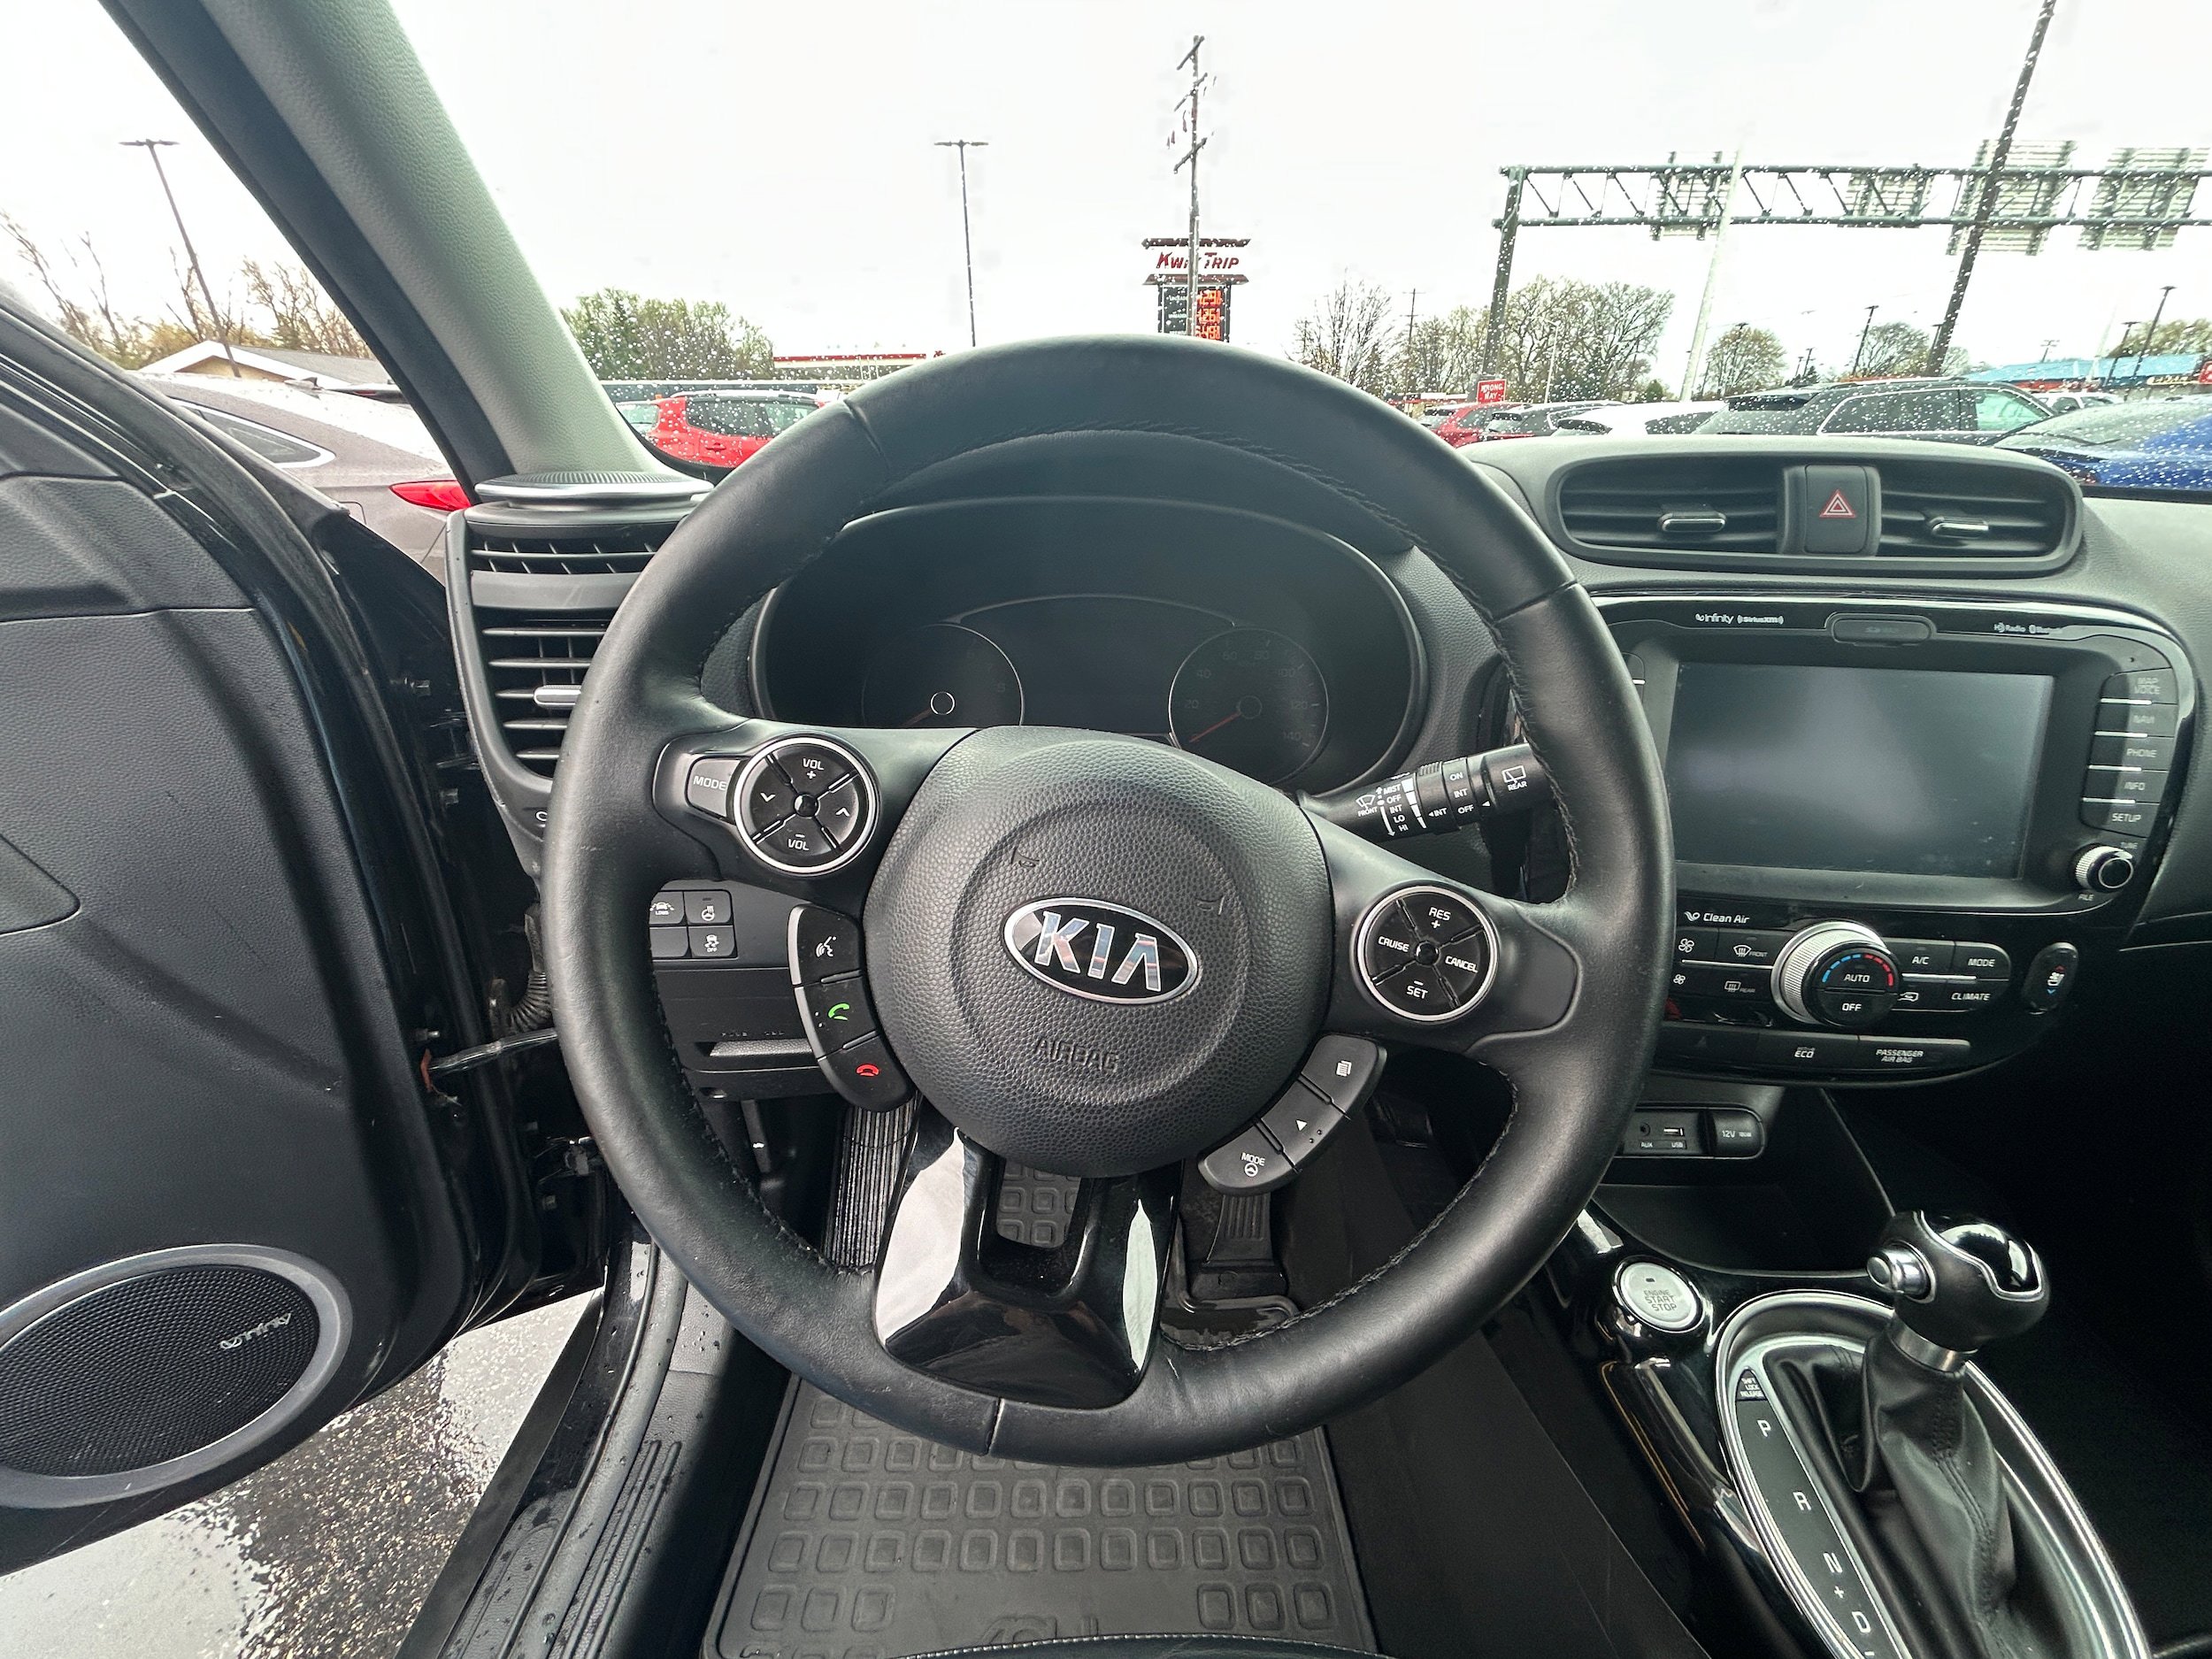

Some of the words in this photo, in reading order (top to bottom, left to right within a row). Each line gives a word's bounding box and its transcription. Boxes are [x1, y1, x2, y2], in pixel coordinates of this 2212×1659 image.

[1484, 391, 1498, 400] WAY
[2134, 685, 2161, 695] VOICE
[2126, 748, 2158, 758] PHONE
[803, 757, 825, 771] VOL
[1449, 772, 1463, 780] ON
[693, 775, 727, 790] MODE
[1507, 781, 1528, 791] REAR
[2124, 781, 2146, 791] INFO
[1383, 783, 1402, 795] MIST
[1454, 788, 1468, 798] INT
[1386, 794, 1402, 804] OFF
[1357, 806, 1378, 817] FRONT
[1389, 803, 1402, 814] INT
[1433, 807, 1448, 818] INT
[1457, 804, 1475, 814] OFF
[1393, 814, 1406, 824] LO
[2111, 812, 2142, 823] SETUP
[787, 839, 810, 851] VOL
[1428, 906, 1451, 921] RES
[1702, 912, 1732, 923] Clean
[1733, 913, 1750, 924] Air
[1378, 935, 1409, 953] CRUISE
[1033, 910, 1162, 993] KIA
[1445, 956, 1479, 973] CANCEL
[1911, 956, 1931, 965] A/C
[1968, 957, 1996, 968] MODE
[1844, 973, 1870, 983] AUTO
[1406, 985, 1429, 1000] SET
[1951, 992, 1991, 1001] CLIMATE
[1841, 1002, 1863, 1012] OFF
[1793, 1049, 1815, 1058] ECO
[1876, 1048, 1924, 1057] PASSENGER
[1721, 1130, 1736, 1139] 12V
[1240, 1152, 1266, 1166] MODE
[1644, 1294, 1675, 1303] START
[1651, 1302, 1677, 1311] STOP
[1756, 1419, 1771, 1437] P
[1793, 1491, 1812, 1511] R
[1823, 1552, 1843, 1574] N
[1851, 1610, 1871, 1633] D
